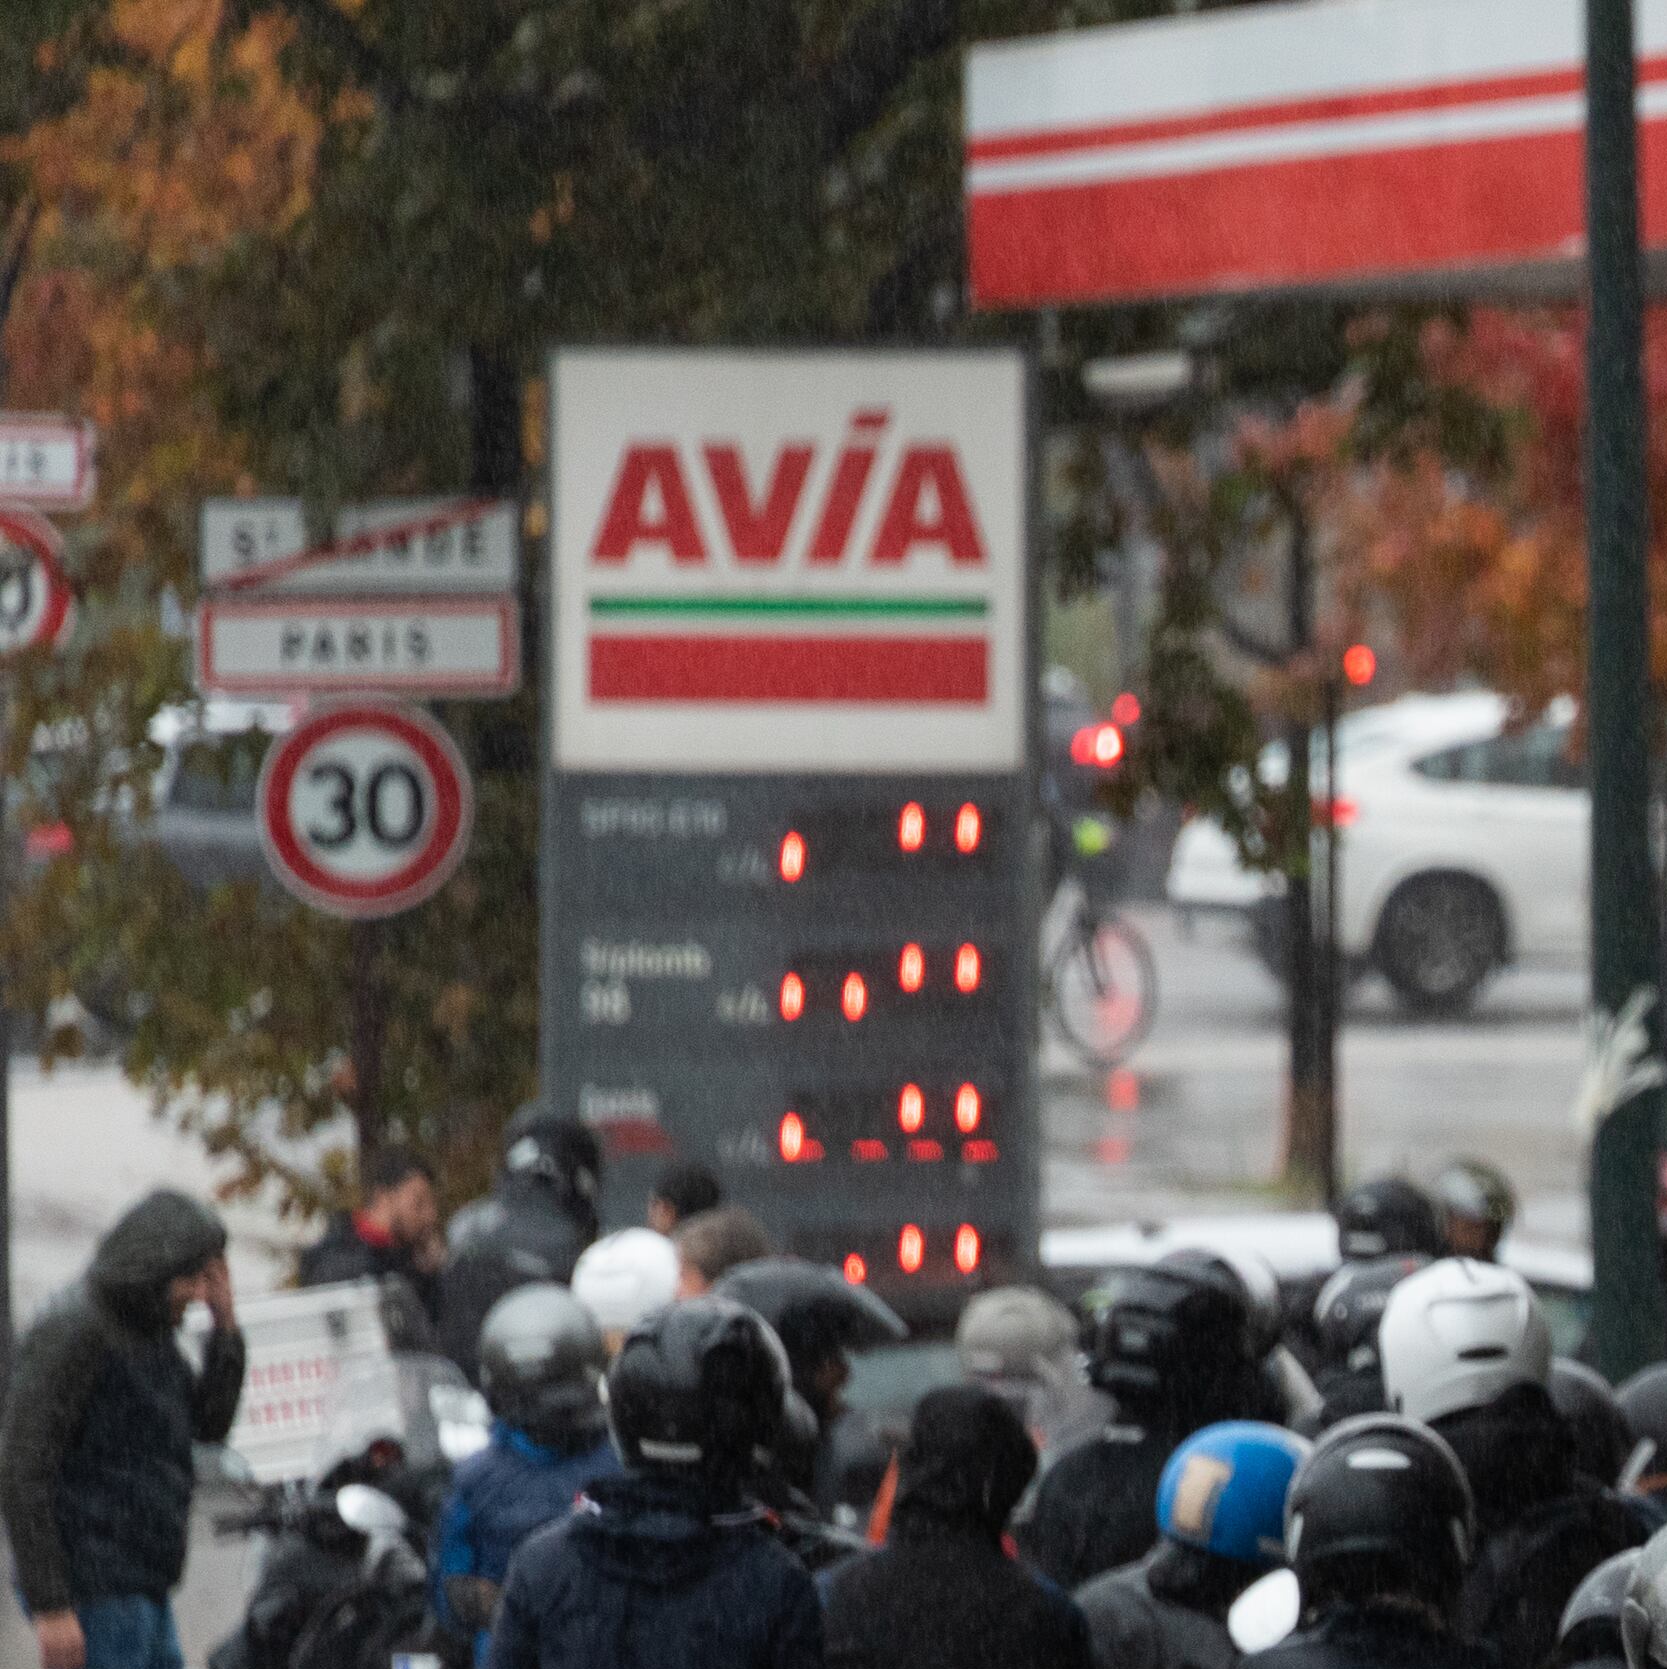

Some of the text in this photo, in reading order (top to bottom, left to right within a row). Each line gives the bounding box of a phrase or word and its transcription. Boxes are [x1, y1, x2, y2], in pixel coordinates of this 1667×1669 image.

[590, 407, 988, 567] AVIA
[279, 617, 432, 666] PARIS
[308, 762, 426, 850] 30
